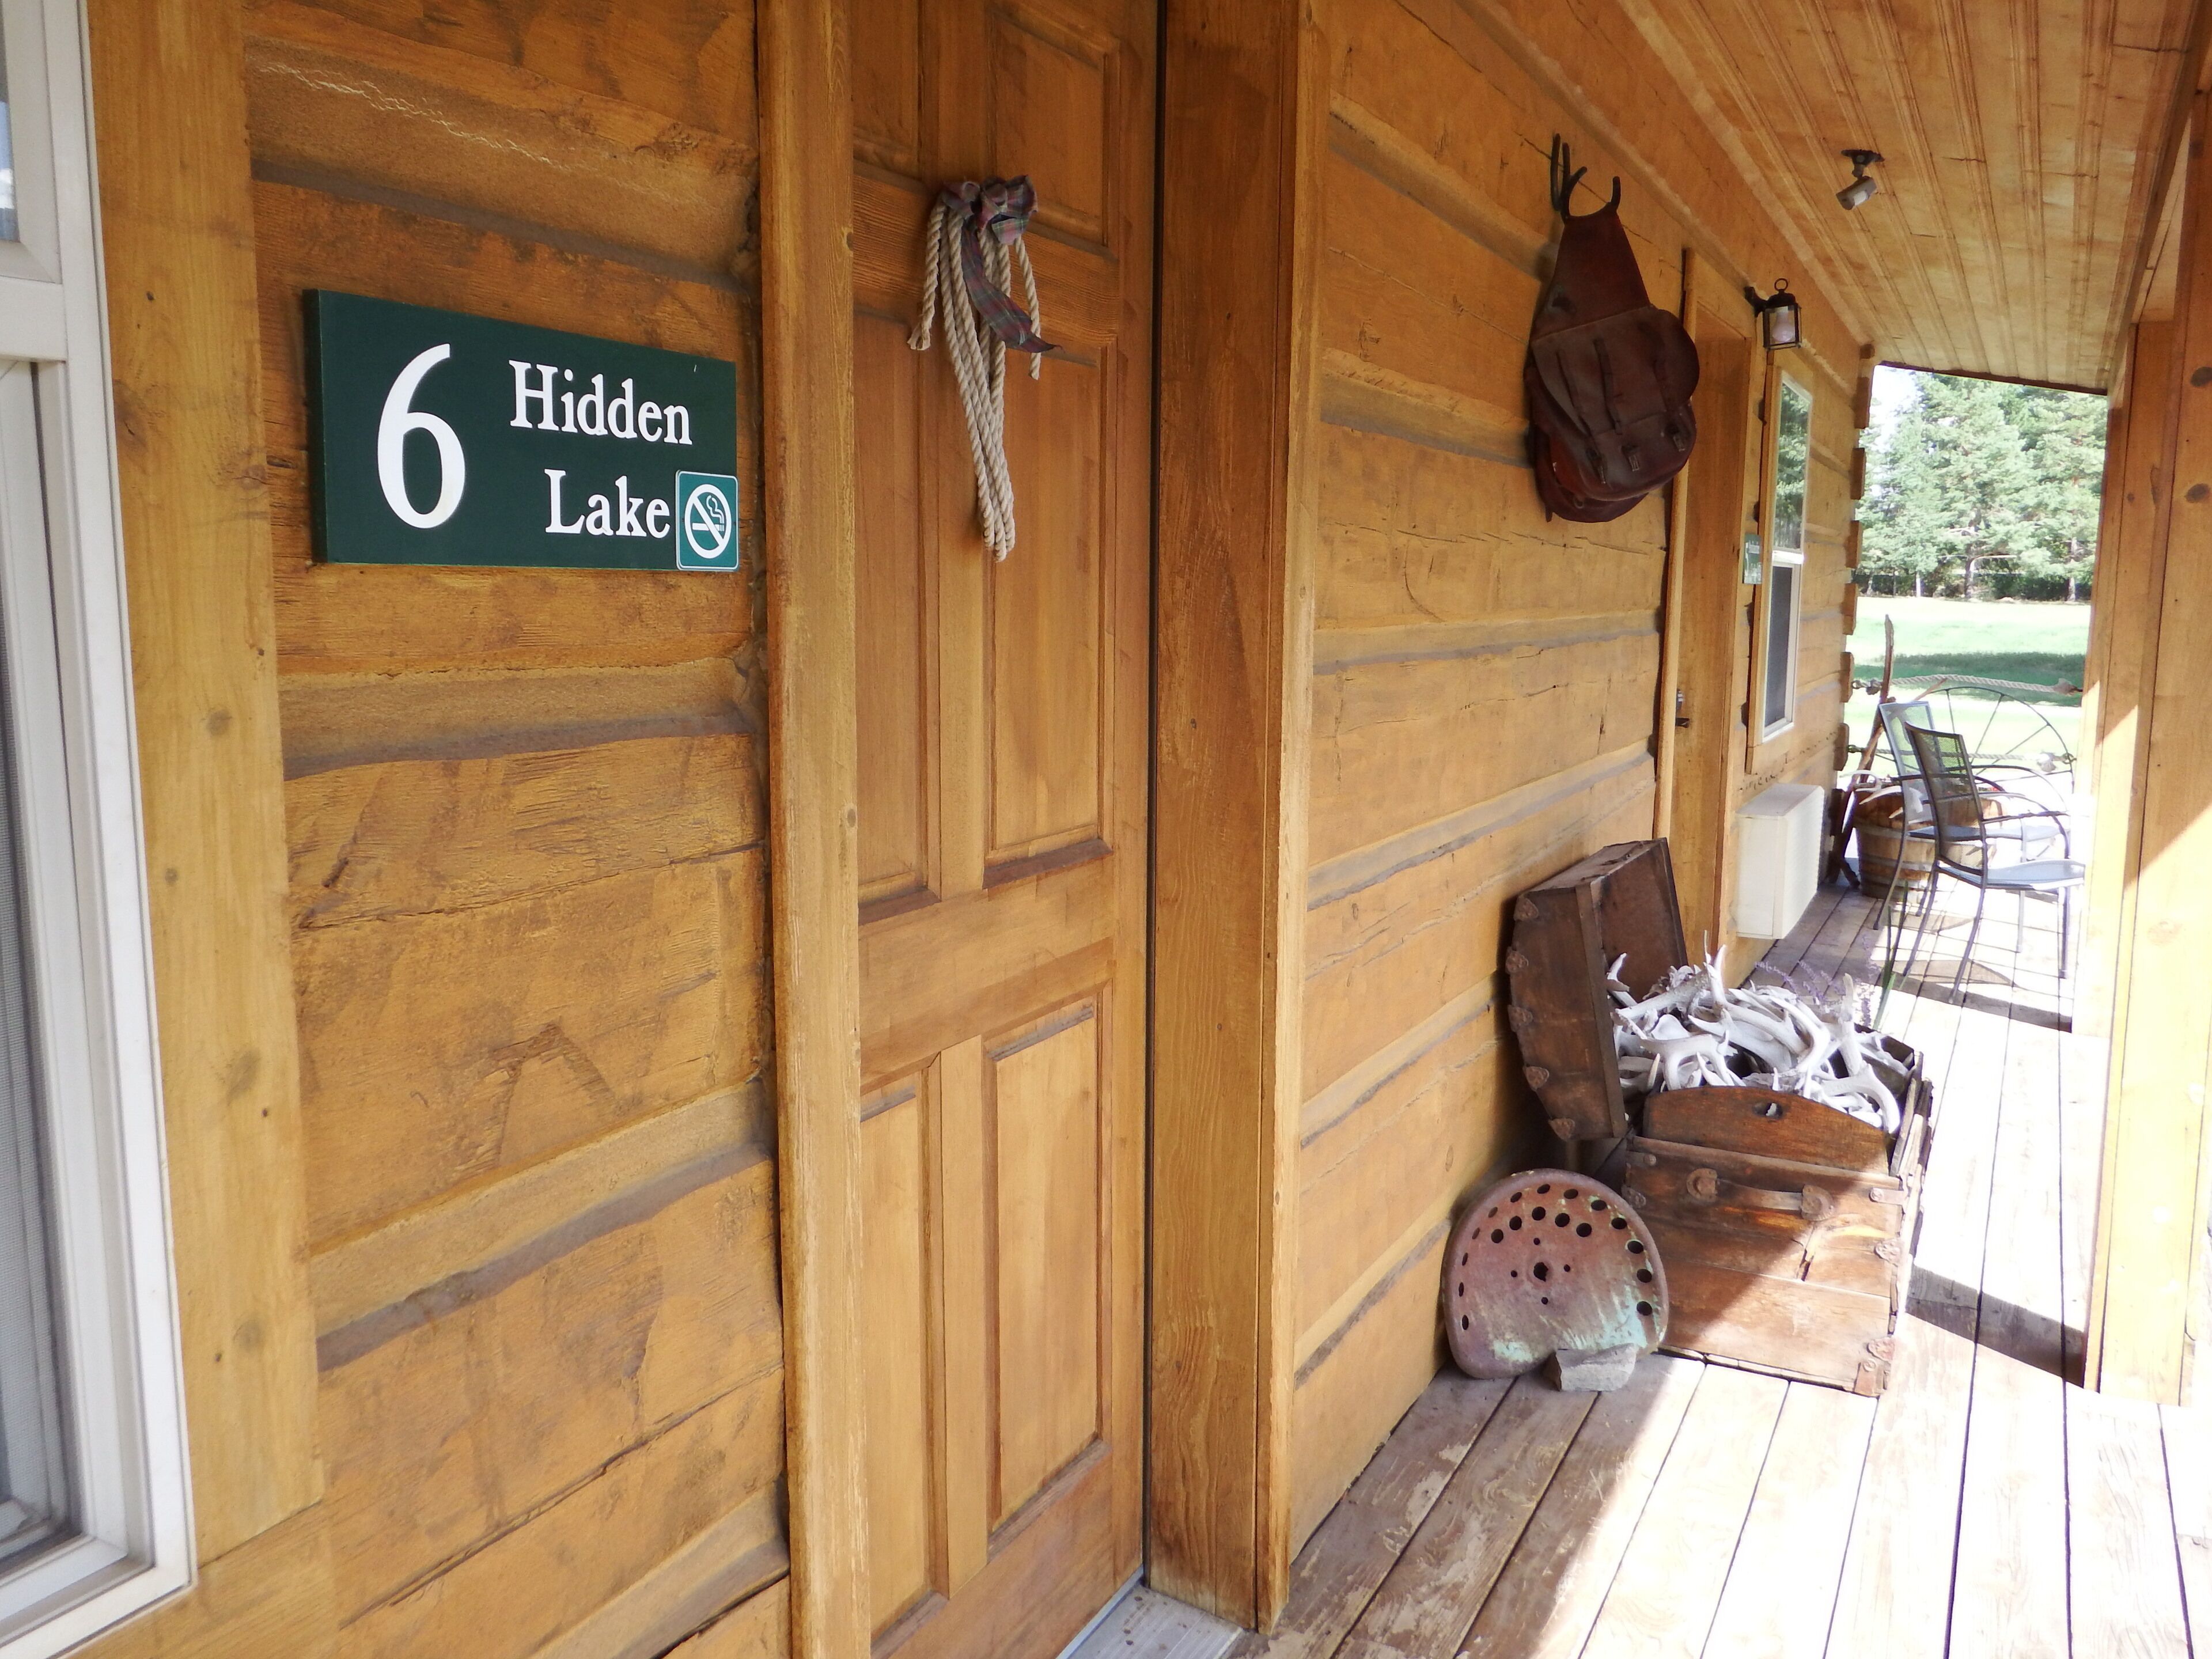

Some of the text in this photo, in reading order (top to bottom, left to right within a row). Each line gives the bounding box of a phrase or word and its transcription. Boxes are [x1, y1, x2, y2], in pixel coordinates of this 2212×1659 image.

[377, 343, 465, 529] 6
[509, 359, 692, 445] Hidden
[544, 468, 671, 539] Lake
